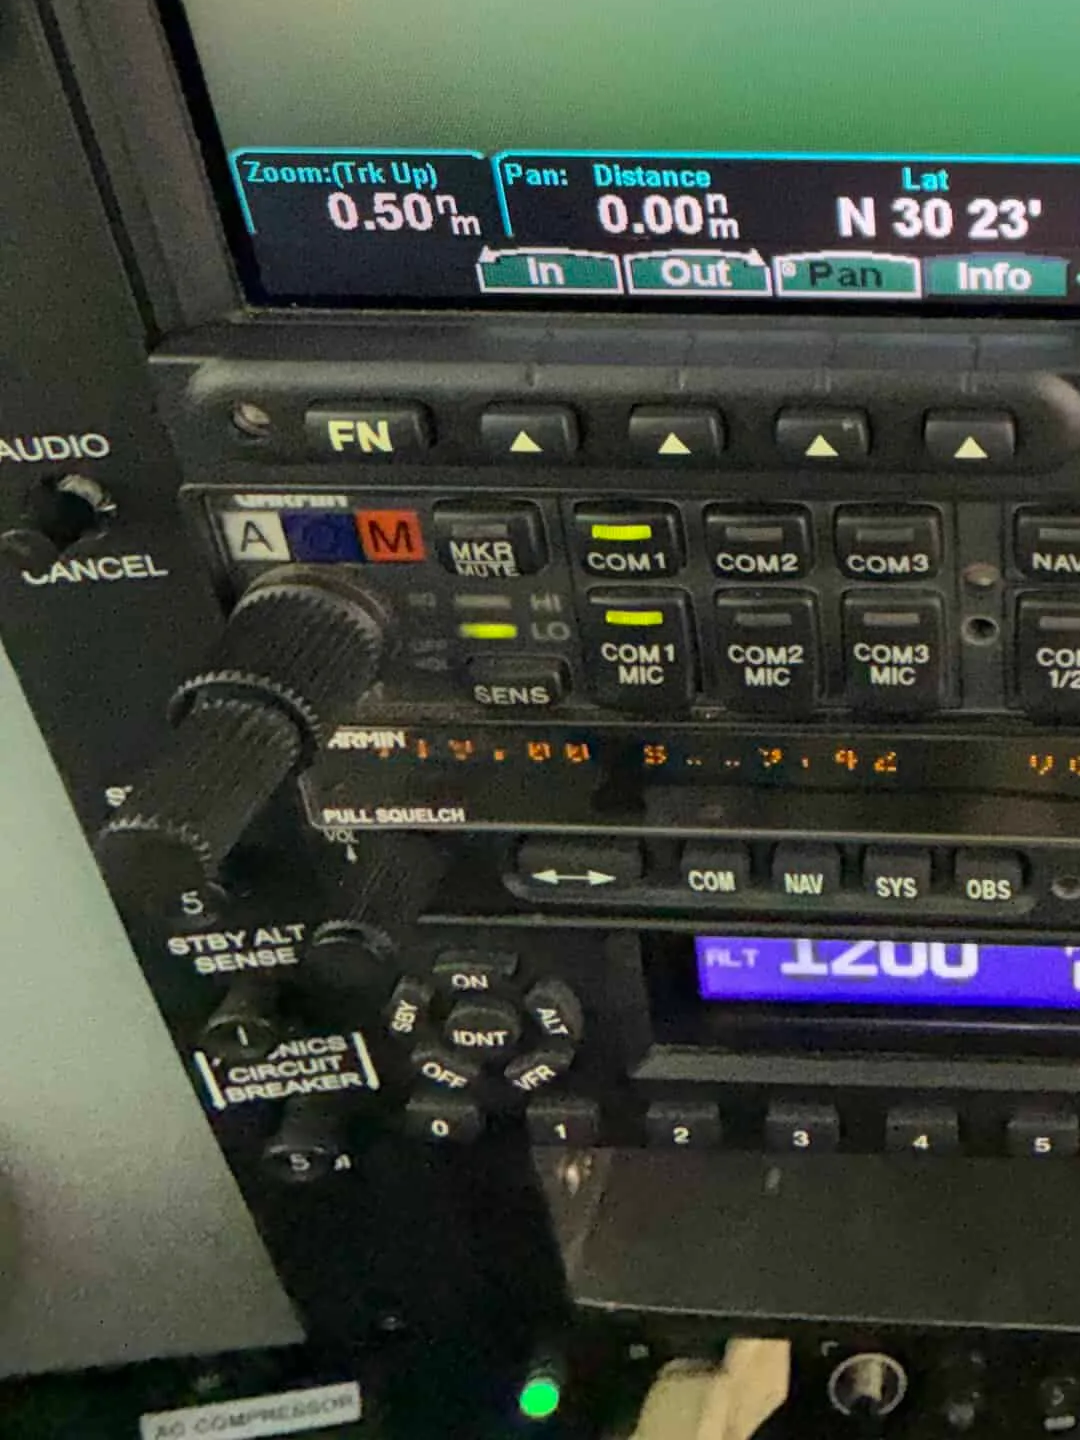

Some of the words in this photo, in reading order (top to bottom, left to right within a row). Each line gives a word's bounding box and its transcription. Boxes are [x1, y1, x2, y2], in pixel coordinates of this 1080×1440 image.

[395, 162, 437, 189] Up)
[506, 164, 567, 187] Pan:
[595, 164, 710, 188] Distance
[902, 168, 948, 191] Lat
[837, 197, 875, 237] N
[893, 198, 952, 239] 30
[528, 261, 564, 286] In
[662, 261, 731, 288] Out
[808, 265, 882, 290] Pan
[957, 260, 1031, 293] Info
[0, 433, 111, 461] AUDIO
[328, 420, 393, 452] FN
[241, 521, 273, 552] A
[368, 520, 414, 553] M
[450, 542, 513, 564] MKR
[717, 553, 799, 573] COM2
[846, 554, 930, 574] COM3
[727, 645, 804, 665] COM2
[854, 644, 930, 665] COM3
[618, 666, 664, 686] MIC
[745, 667, 791, 687] MIC
[870, 667, 917, 687] MIC
[473, 684, 550, 705] SENS
[328, 731, 407, 749] ARMIN
[323, 808, 373, 825] PULL
[375, 807, 466, 824] SQUELCH
[688, 870, 737, 893] COM
[785, 873, 823, 895] NAV
[876, 876, 917, 898] SYS
[967, 879, 1011, 901] OBS
[167, 929, 245, 956] STBY
[253, 924, 305, 947] ALT
[194, 948, 298, 975] SENSE
[452, 973, 489, 991] ON
[392, 1000, 418, 1033] SBY
[537, 1005, 570, 1038] ALT
[454, 1030, 508, 1048] IDNT
[228, 1056, 343, 1083] CIRCUIT
[421, 1062, 468, 1091] OFF
[513, 1065, 557, 1092] VFR
[224, 1072, 363, 1103] BREAKER
[554, 1123, 567, 1139] 1
[673, 1127, 690, 1144] 2
[793, 1130, 810, 1148] 3
[912, 1134, 930, 1150] 4
[1035, 1136, 1051, 1153] 5
